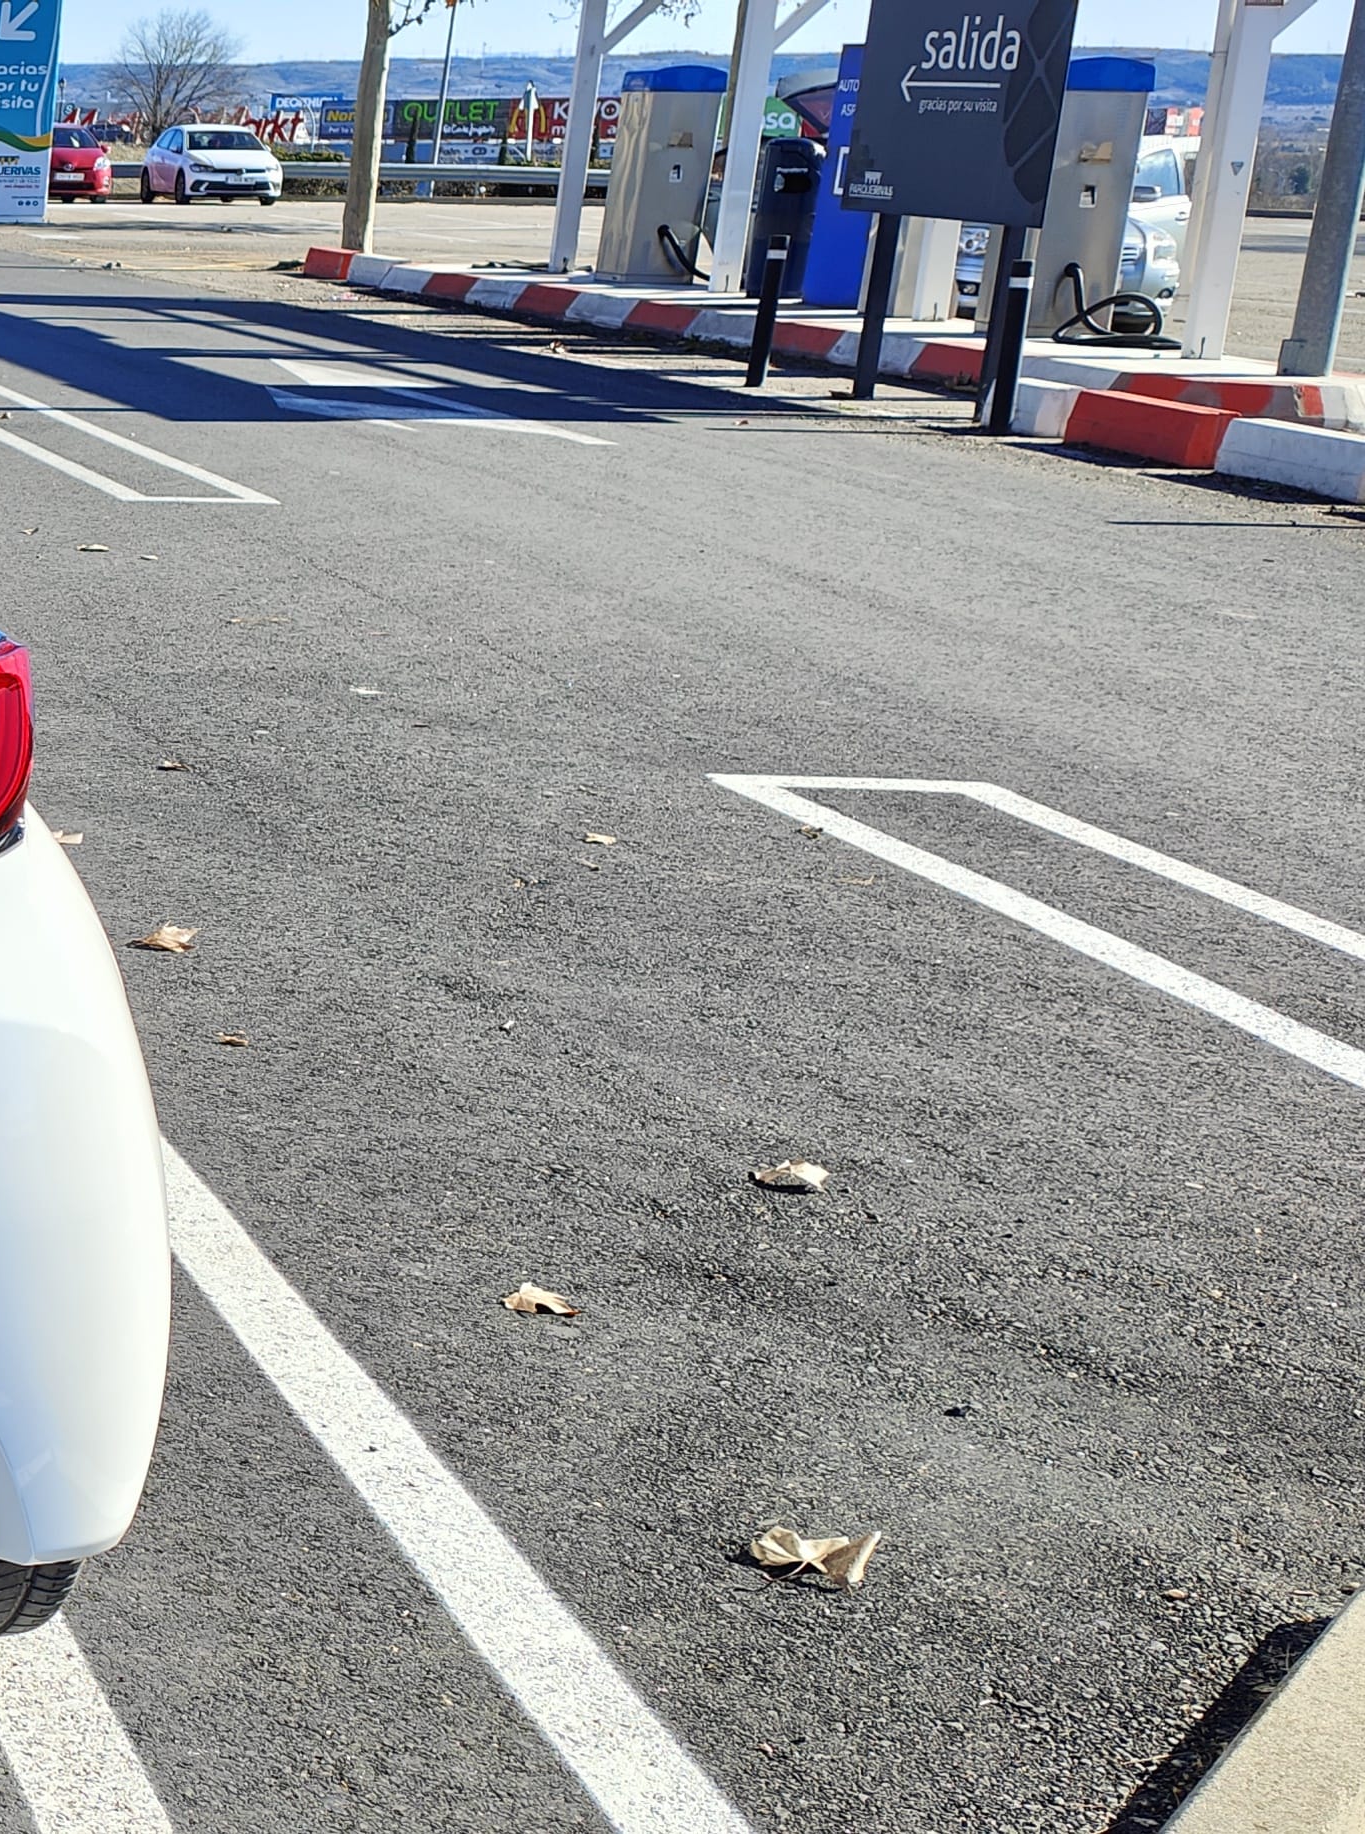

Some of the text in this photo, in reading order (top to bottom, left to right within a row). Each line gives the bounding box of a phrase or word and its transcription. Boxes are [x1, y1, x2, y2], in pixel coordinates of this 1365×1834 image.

[921, 15, 1021, 70] salida
[20, 79, 39, 92] tu
[403, 101, 499, 123] OUTLET
[919, 97, 997, 115] gracias por su visita
